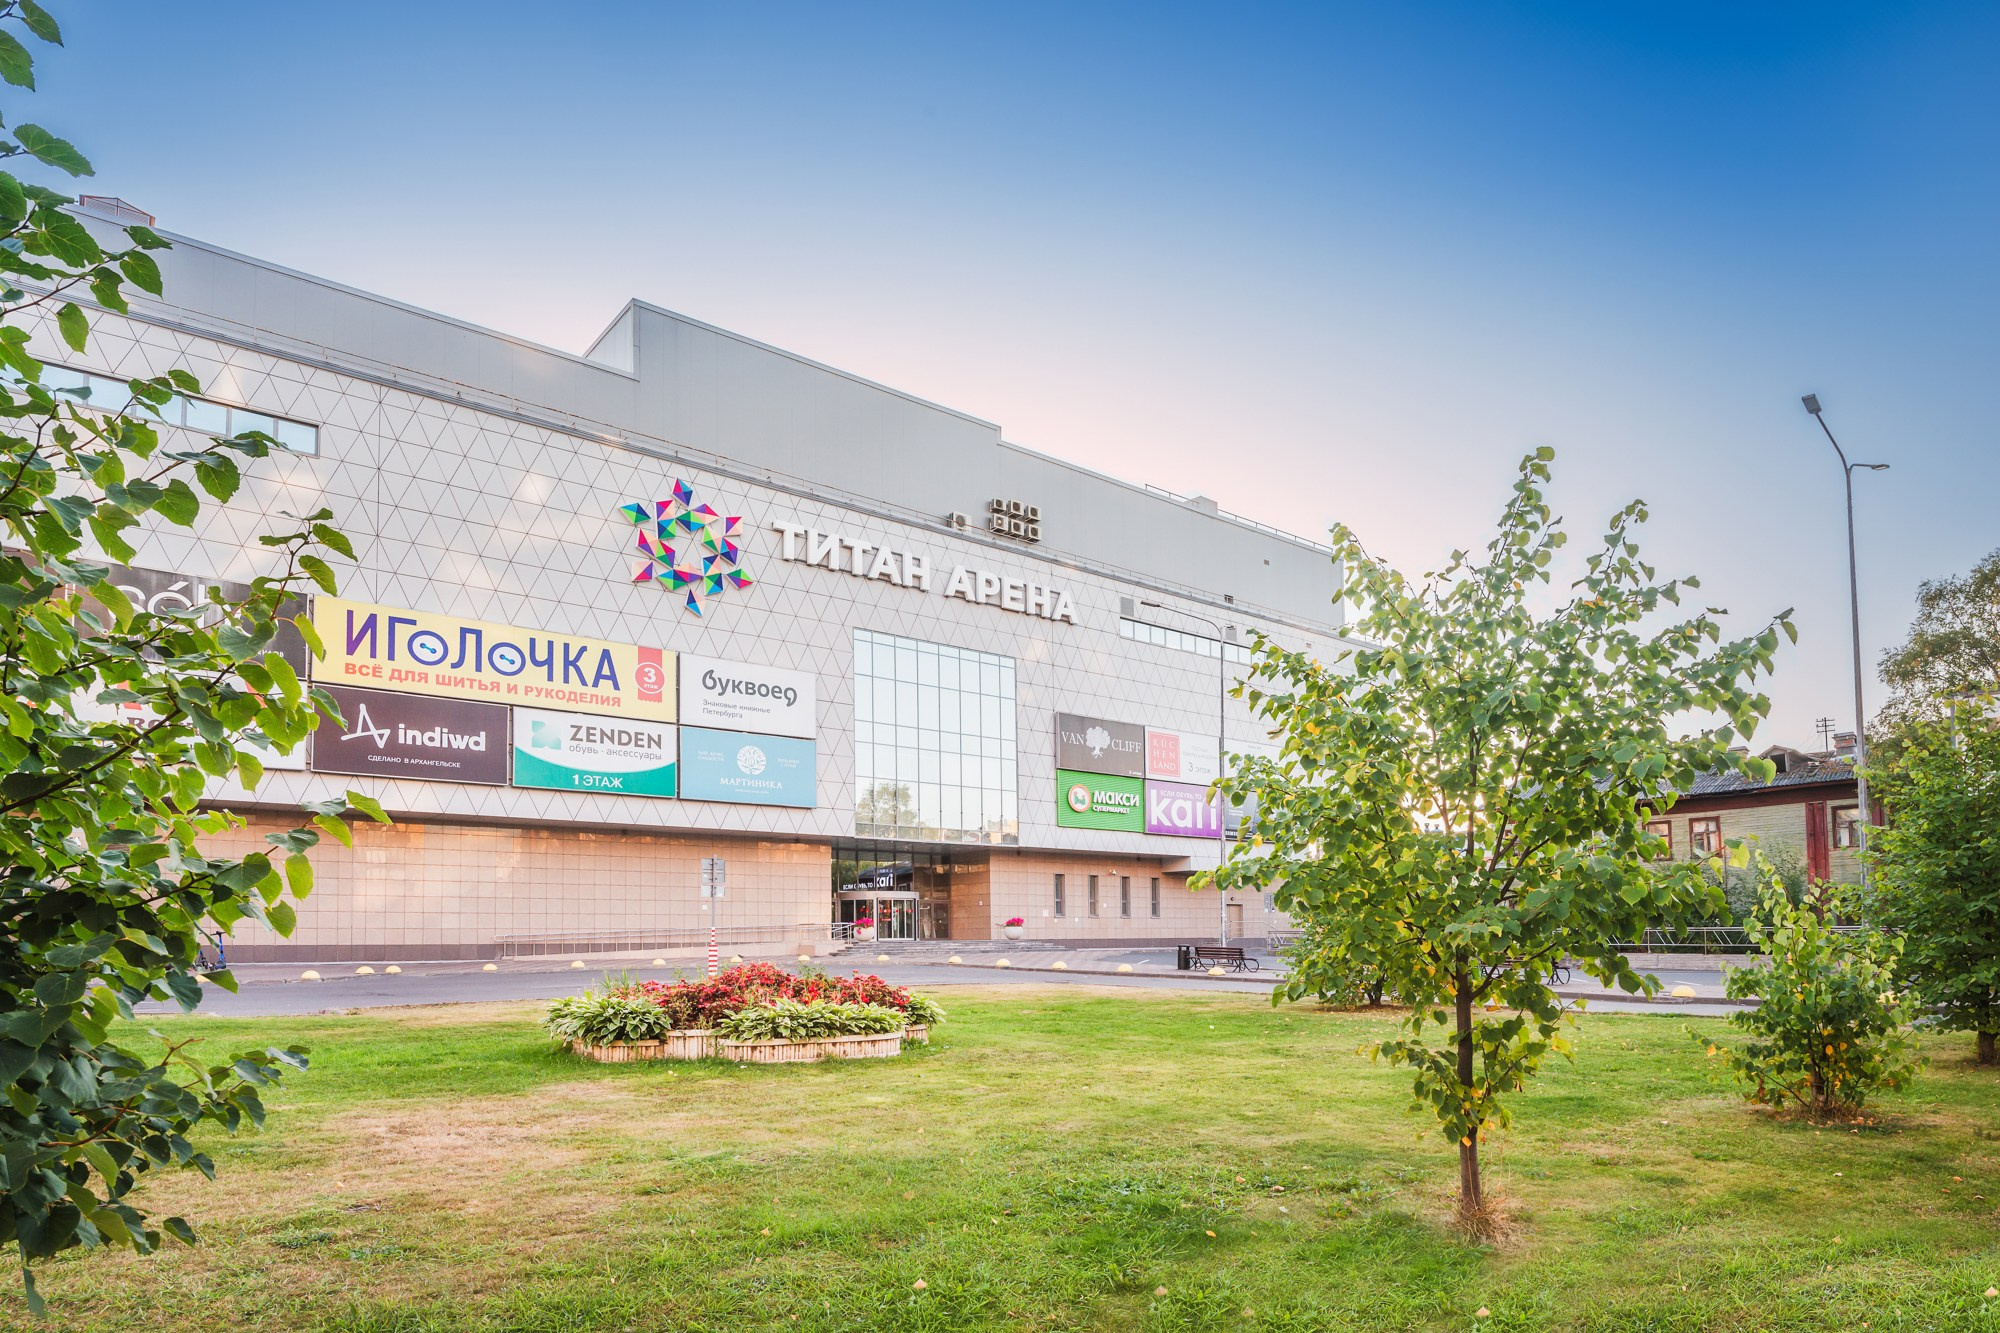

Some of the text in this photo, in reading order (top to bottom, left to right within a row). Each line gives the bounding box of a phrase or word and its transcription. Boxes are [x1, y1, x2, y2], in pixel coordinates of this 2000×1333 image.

[772, 518, 1079, 625] ТИТАН АРЕНА
[346, 609, 621, 691] ИГОЛОЧКА
[643, 667, 657, 683] 3
[344, 662, 622, 708] ВСЁ ДЛЯ ШИТЬЯ И РУКОДЕЛИЯ
[702, 699, 771, 714] Знаковые книжные
[702, 707, 743, 719] Петербурга
[398, 723, 486, 752] indiwd
[570, 724, 662, 750] ZENDEN
[1061, 731, 1142, 753] VAN CLIFF
[569, 743, 662, 761] обувь аксессуары
[1153, 750, 1176, 760] HEN
[367, 754, 401, 763] СДЕЛАНО
[410, 758, 461, 768] АРХАНГЕЛЬСКЕ
[1153, 759, 1176, 771] LAND
[1188, 761, 1193, 772] 3
[572, 773, 623, 789] 1 ЭТАЖ
[720, 777, 783, 789] МАРТИНИКА
[1160, 789, 1175, 797] ЕСЛИ
[1092, 804, 1130, 814] СУПЕРМАРКЕТ
[1150, 789, 1217, 830] kari
